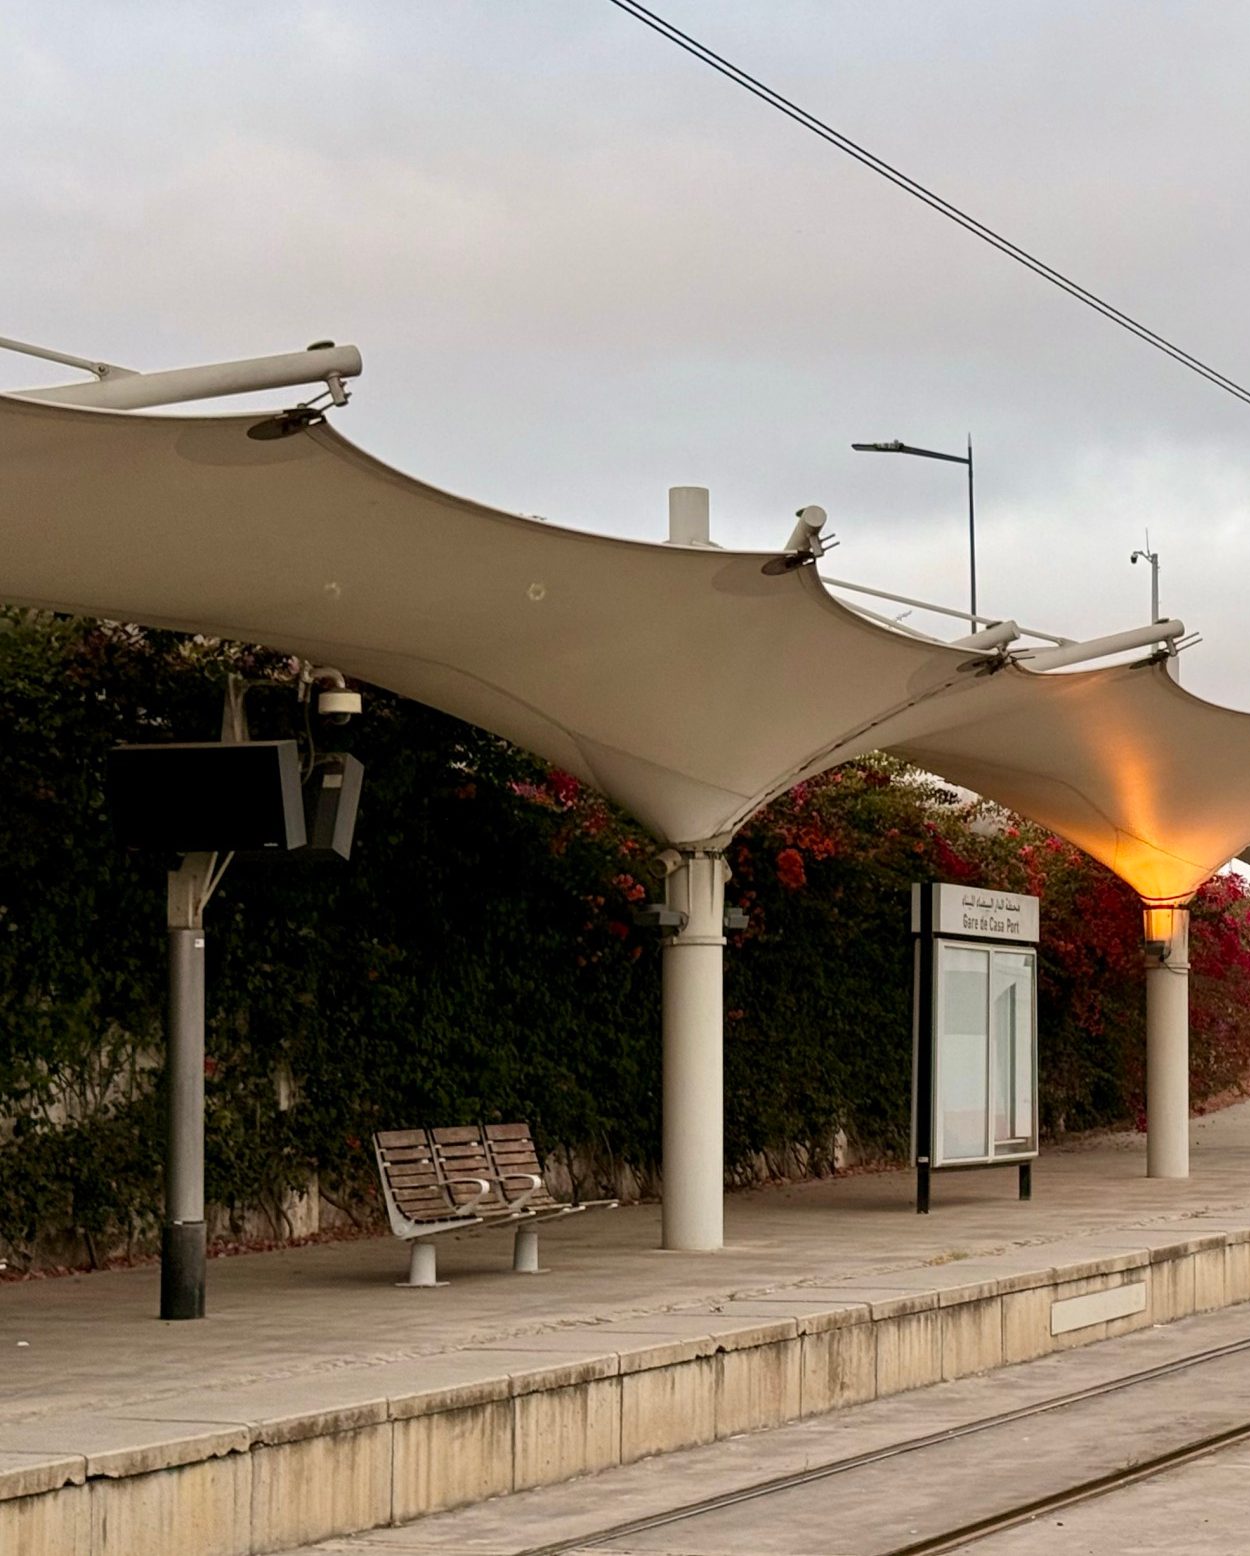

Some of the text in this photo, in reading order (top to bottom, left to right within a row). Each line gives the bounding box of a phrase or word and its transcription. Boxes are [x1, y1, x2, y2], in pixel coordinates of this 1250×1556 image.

[963, 913, 1019, 934] Gare de Casa Port
